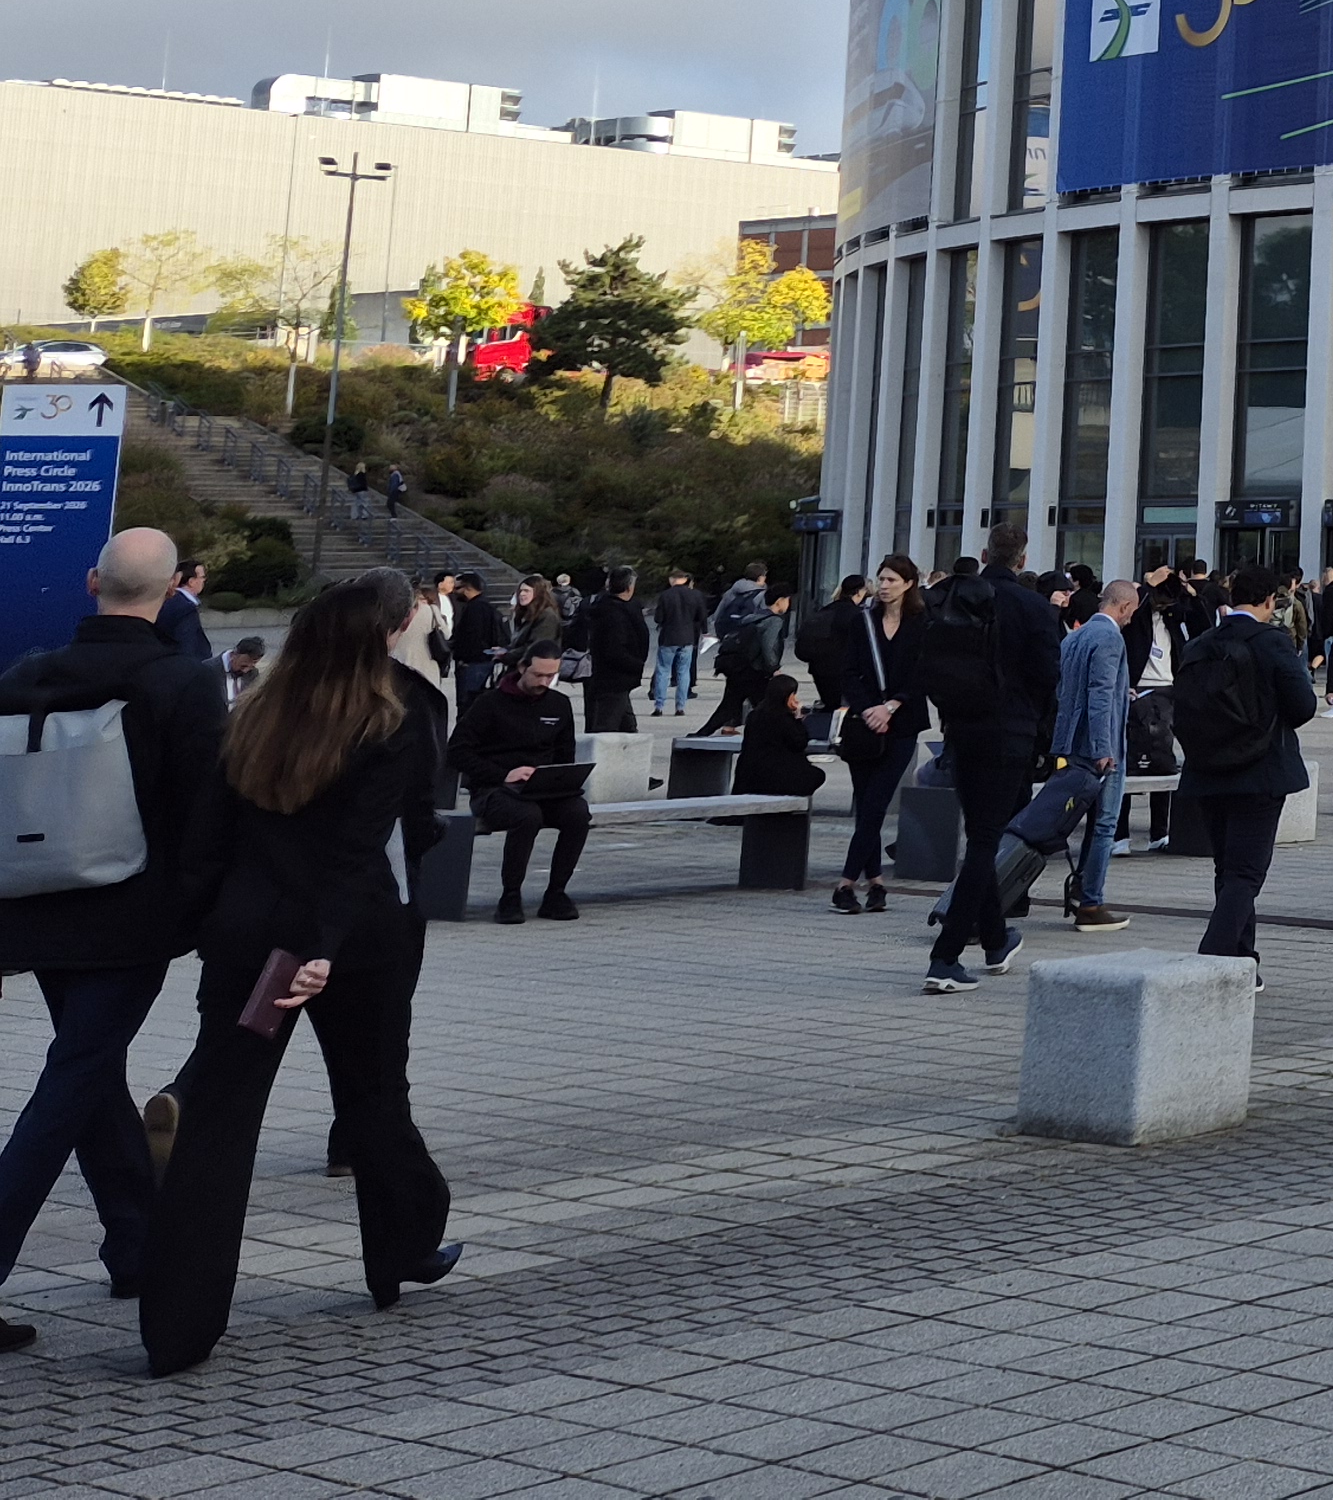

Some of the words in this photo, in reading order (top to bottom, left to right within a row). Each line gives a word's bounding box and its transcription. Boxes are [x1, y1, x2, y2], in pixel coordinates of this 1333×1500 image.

[5, 449, 93, 461] International
[4, 465, 38, 477] Press
[40, 465, 77, 477] Circle
[2, 481, 67, 492] InnoTrans
[68, 480, 102, 492] 2026
[13, 501, 63, 511] September
